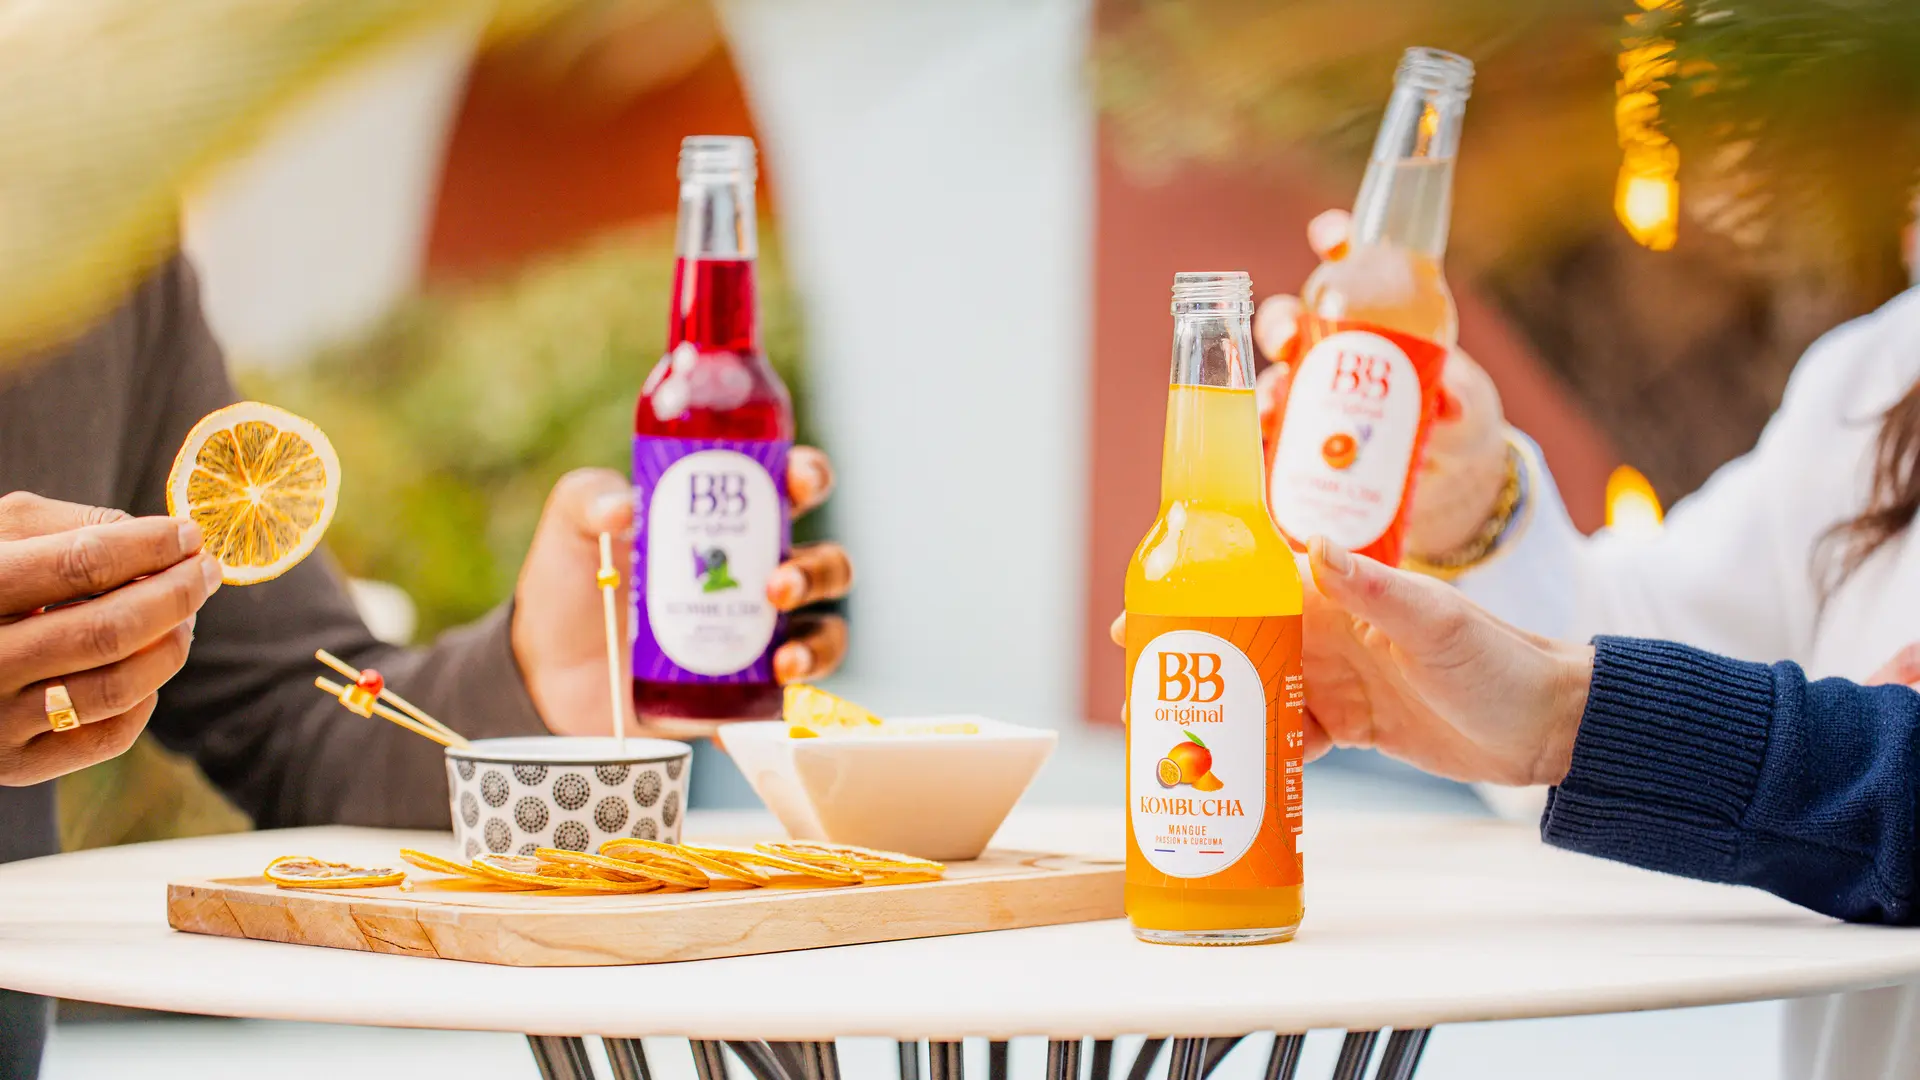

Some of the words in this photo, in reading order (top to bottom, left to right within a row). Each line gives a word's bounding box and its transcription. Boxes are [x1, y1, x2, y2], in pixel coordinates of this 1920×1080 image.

[688, 473, 748, 516] BB
[1157, 651, 1225, 703] BB
[1155, 704, 1224, 726] original
[1140, 796, 1245, 817] KOMBUCHA
[1155, 835, 1181, 845] PASSION
[1190, 837, 1223, 846] CURCUMA
[1168, 824, 1207, 836] MANGUE
